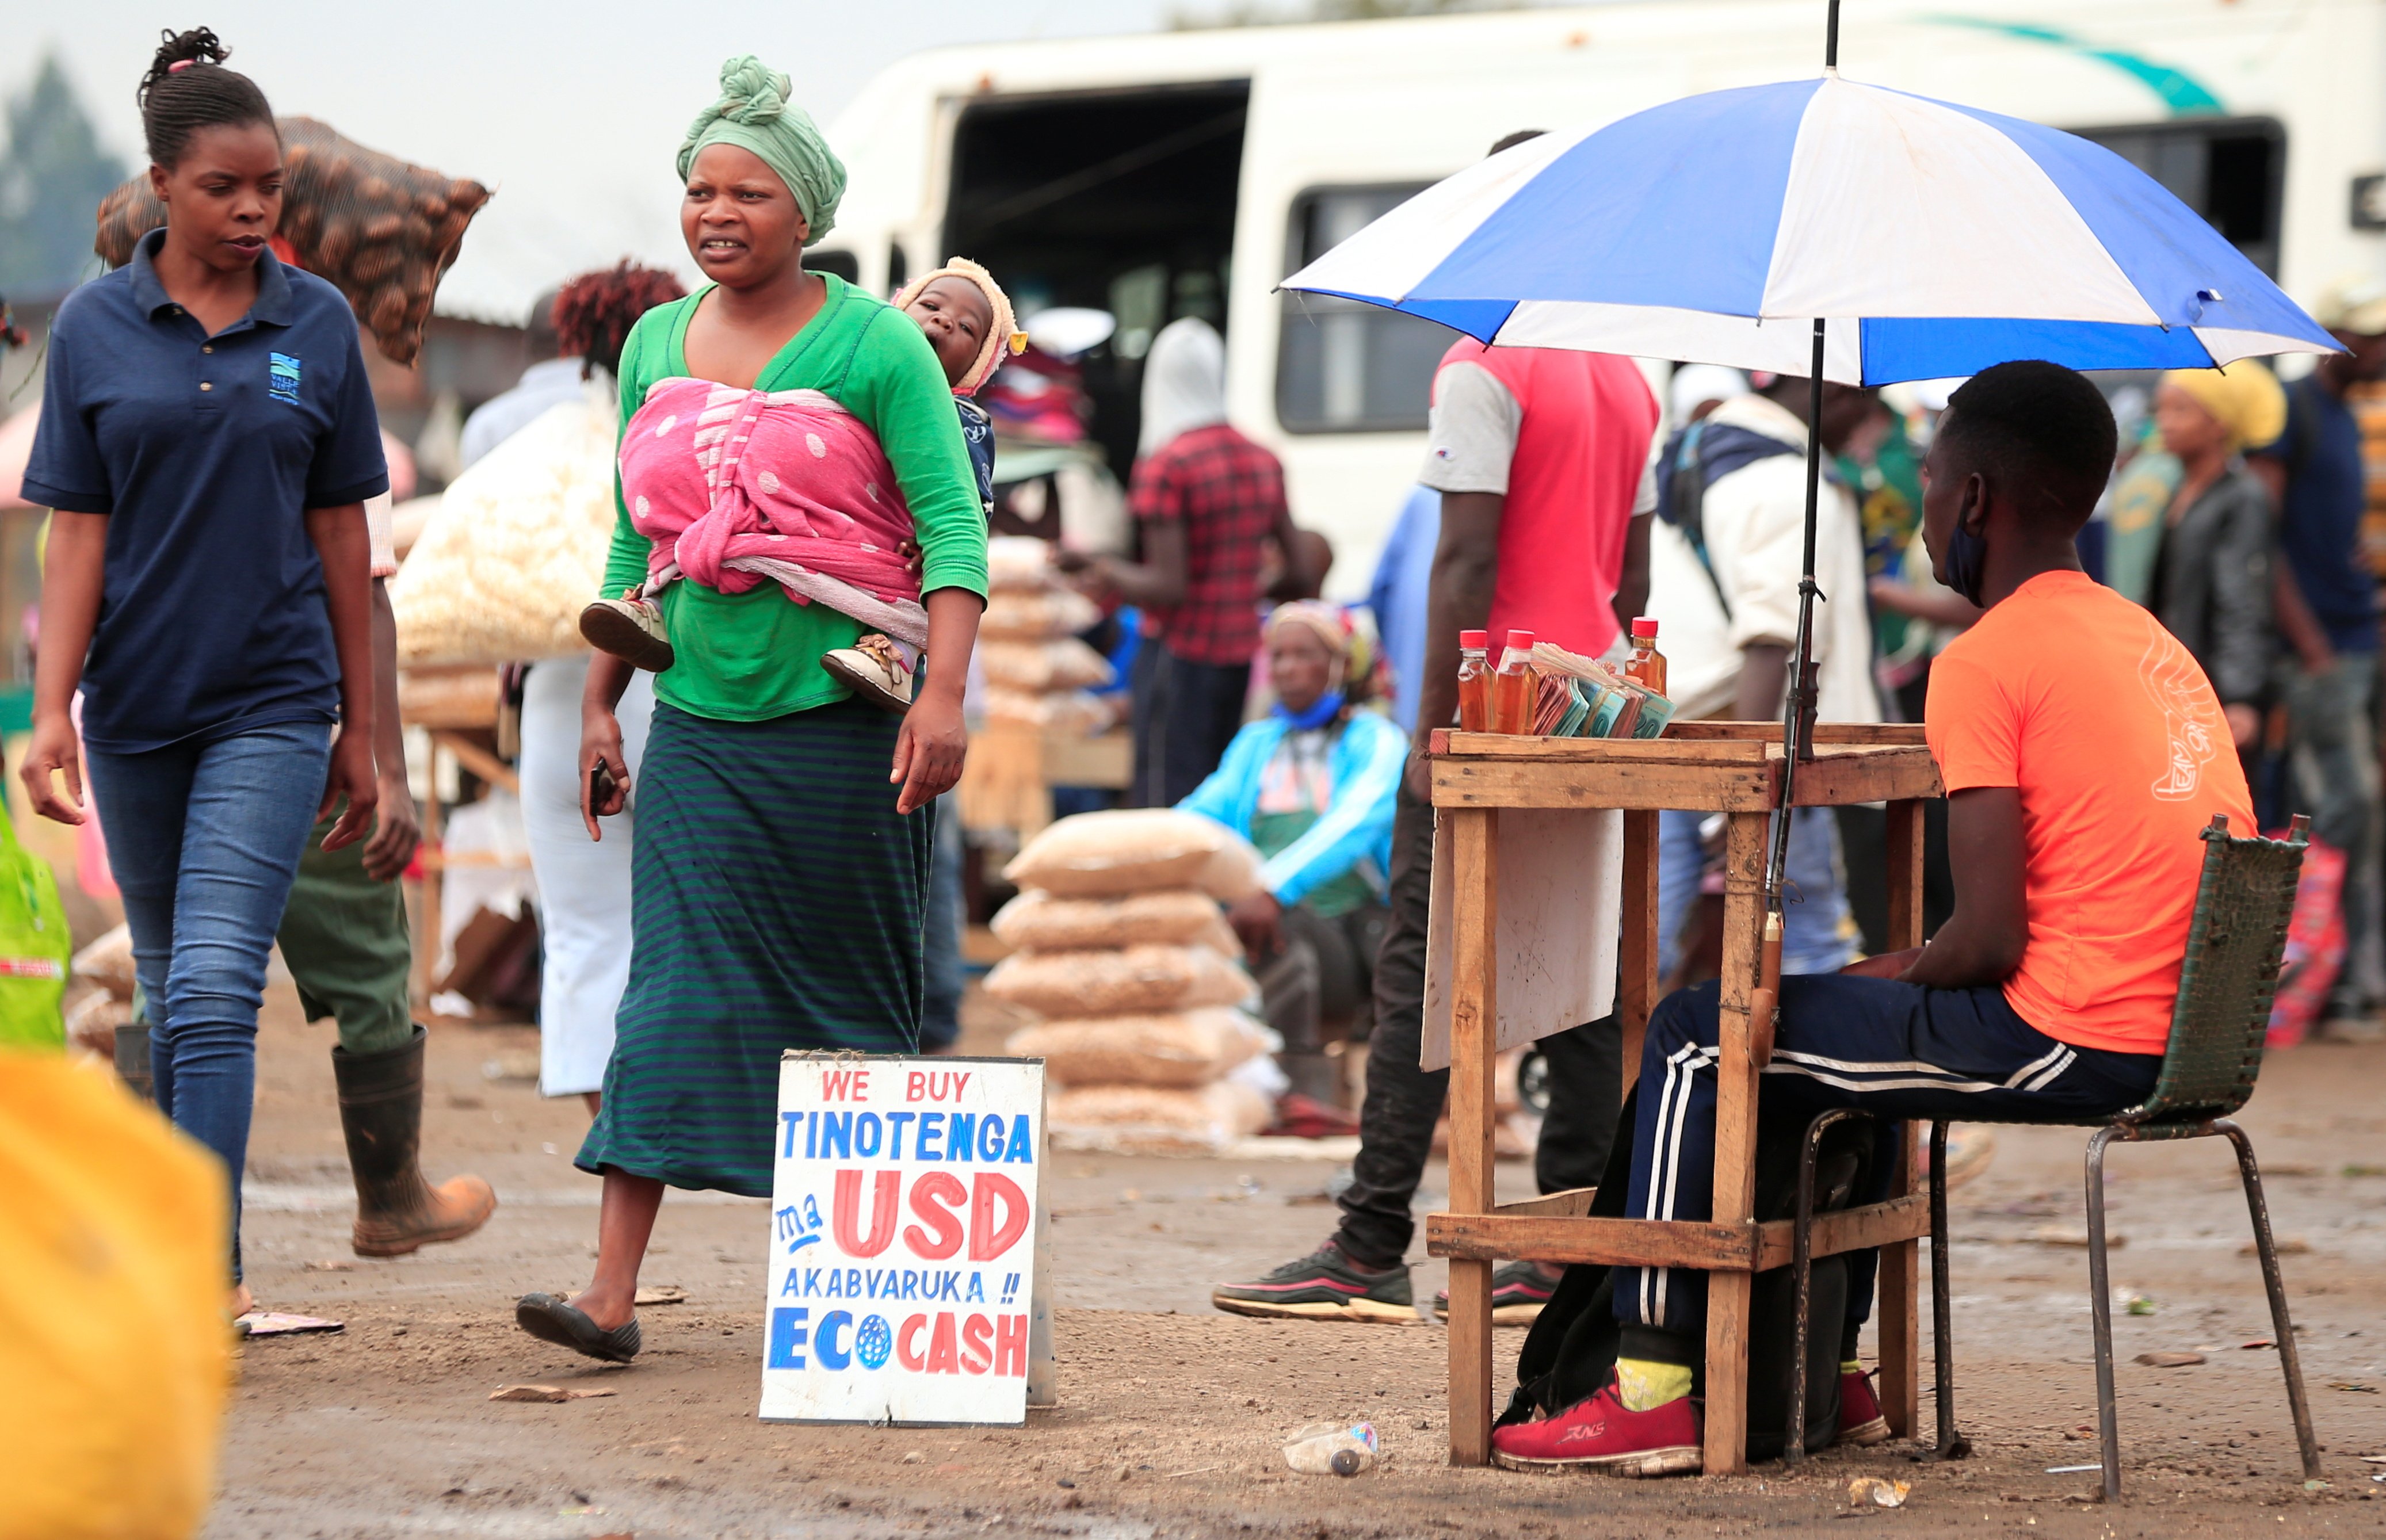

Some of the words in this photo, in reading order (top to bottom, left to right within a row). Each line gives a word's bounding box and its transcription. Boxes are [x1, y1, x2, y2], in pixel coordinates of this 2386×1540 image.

[822, 1071, 870, 1102] WE
[906, 1072, 971, 1103] BUY
[781, 1111, 1033, 1164] TINOTENGA
[832, 1170, 1029, 1262] USD
[780, 1268, 985, 1304] AKABVARUKA
